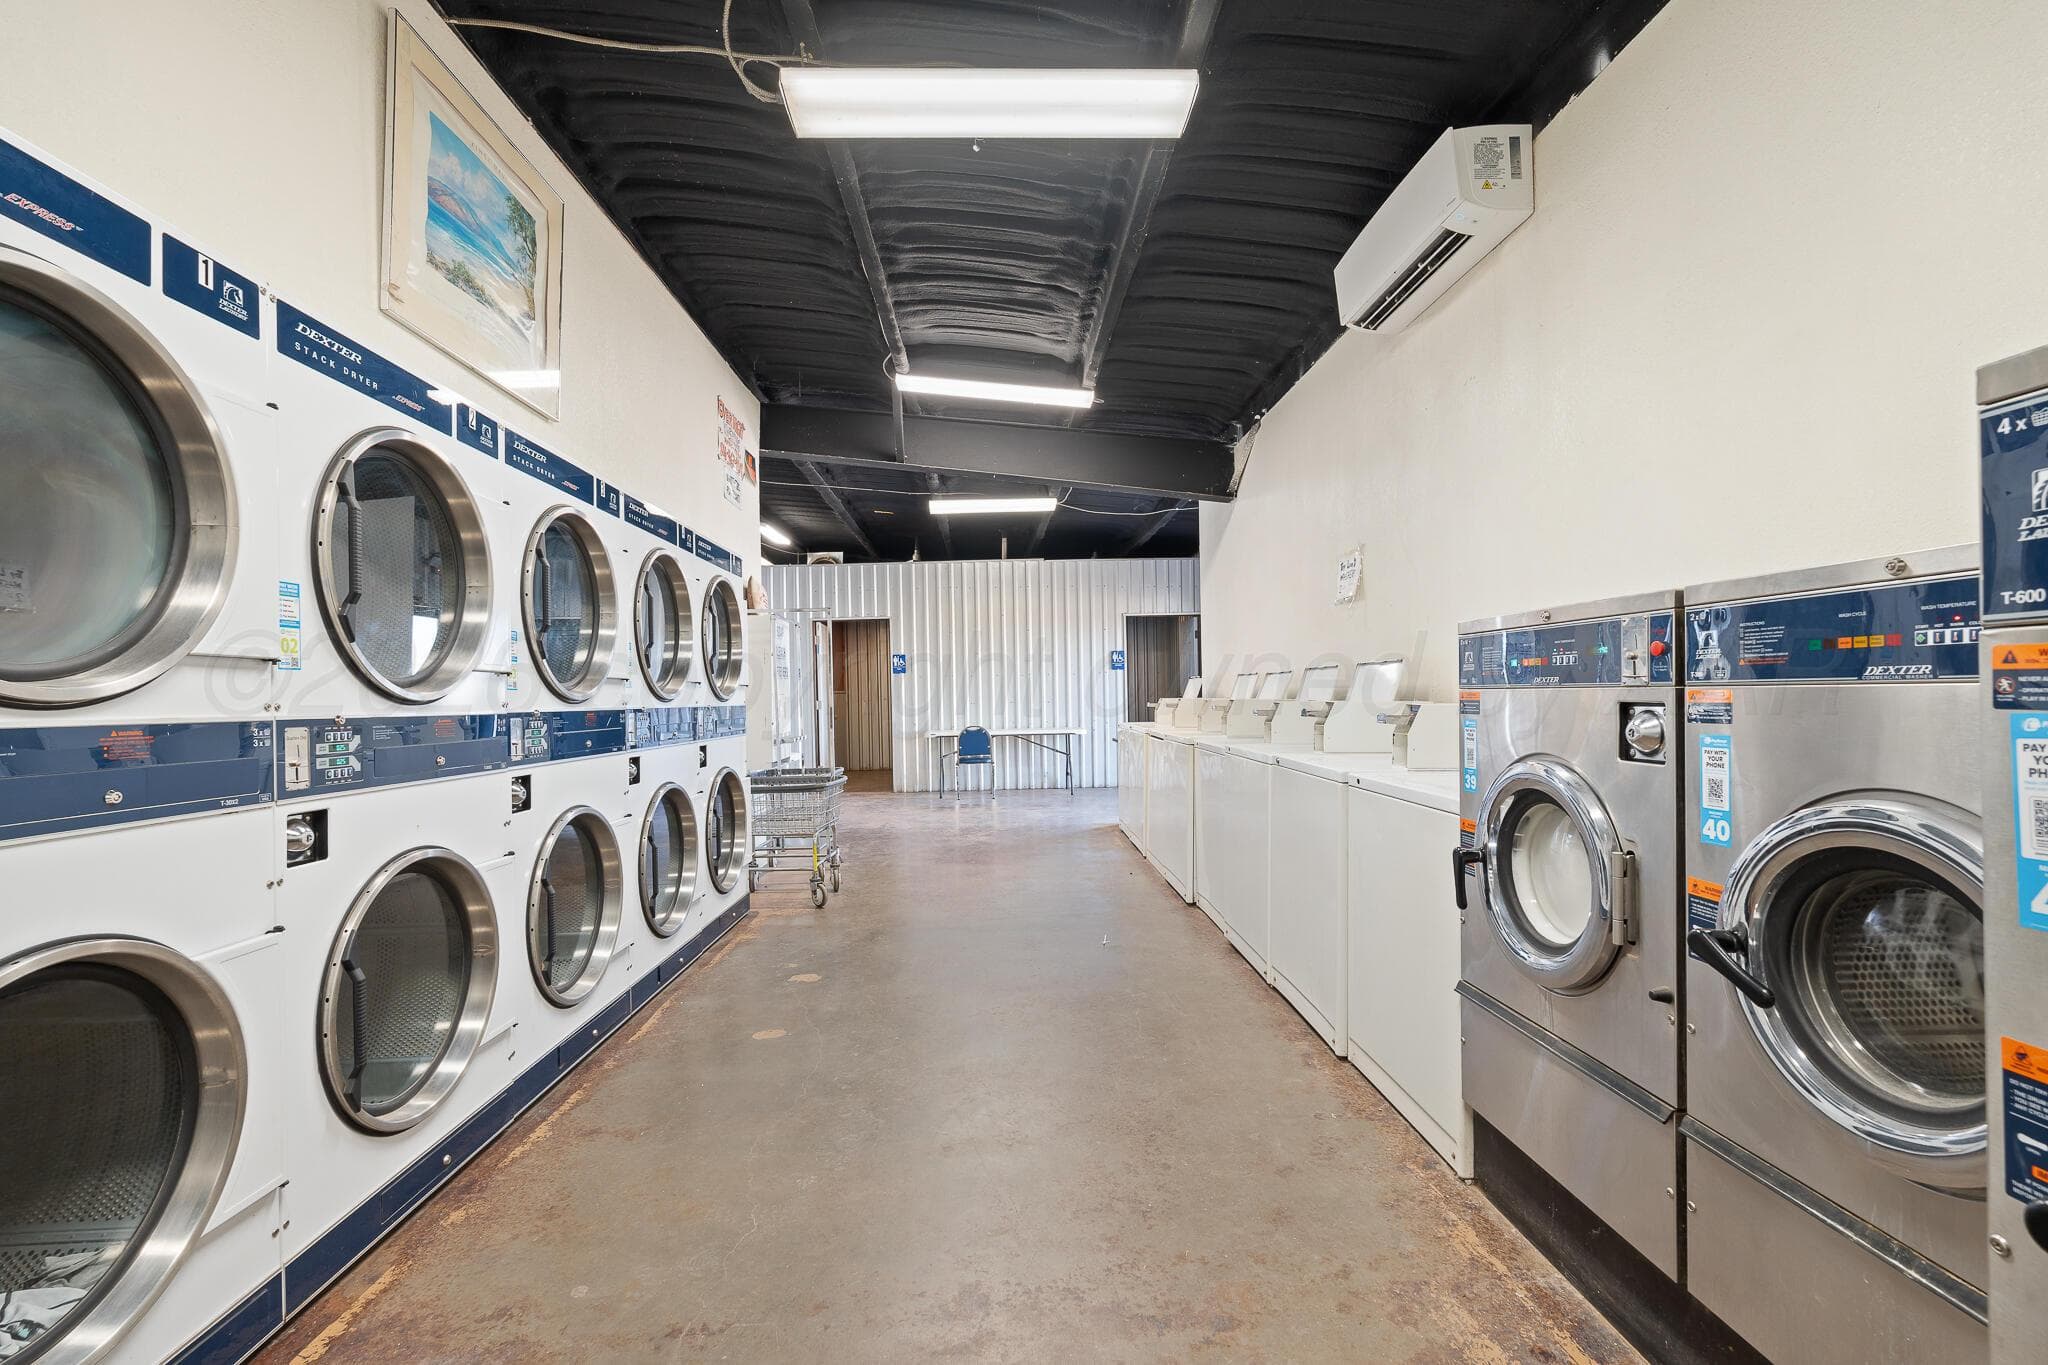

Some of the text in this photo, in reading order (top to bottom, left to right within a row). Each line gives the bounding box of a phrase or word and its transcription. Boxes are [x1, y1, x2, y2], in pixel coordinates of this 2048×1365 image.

[3, 192, 76, 231] EXPRESS
[202, 259, 209, 286] 1
[220, 298, 247, 316] DEXTER
[295, 322, 362, 364] DEXTER
[295, 341, 378, 390] STACK DRYER
[1997, 417, 2028, 435] 4 x
[513, 440, 547, 464] DEXTER
[2000, 588, 2047, 605] T-600
[281, 638, 298, 654] 02
[1863, 664, 1933, 676] DEXTER
[1533, 676, 1560, 684] DEXTER
[253, 729, 258, 737] 3
[2023, 743, 2046, 752] PAY
[1706, 761, 1725, 769] PHONE
[1465, 774, 1477, 790] 39
[1703, 819, 1731, 842] 40
